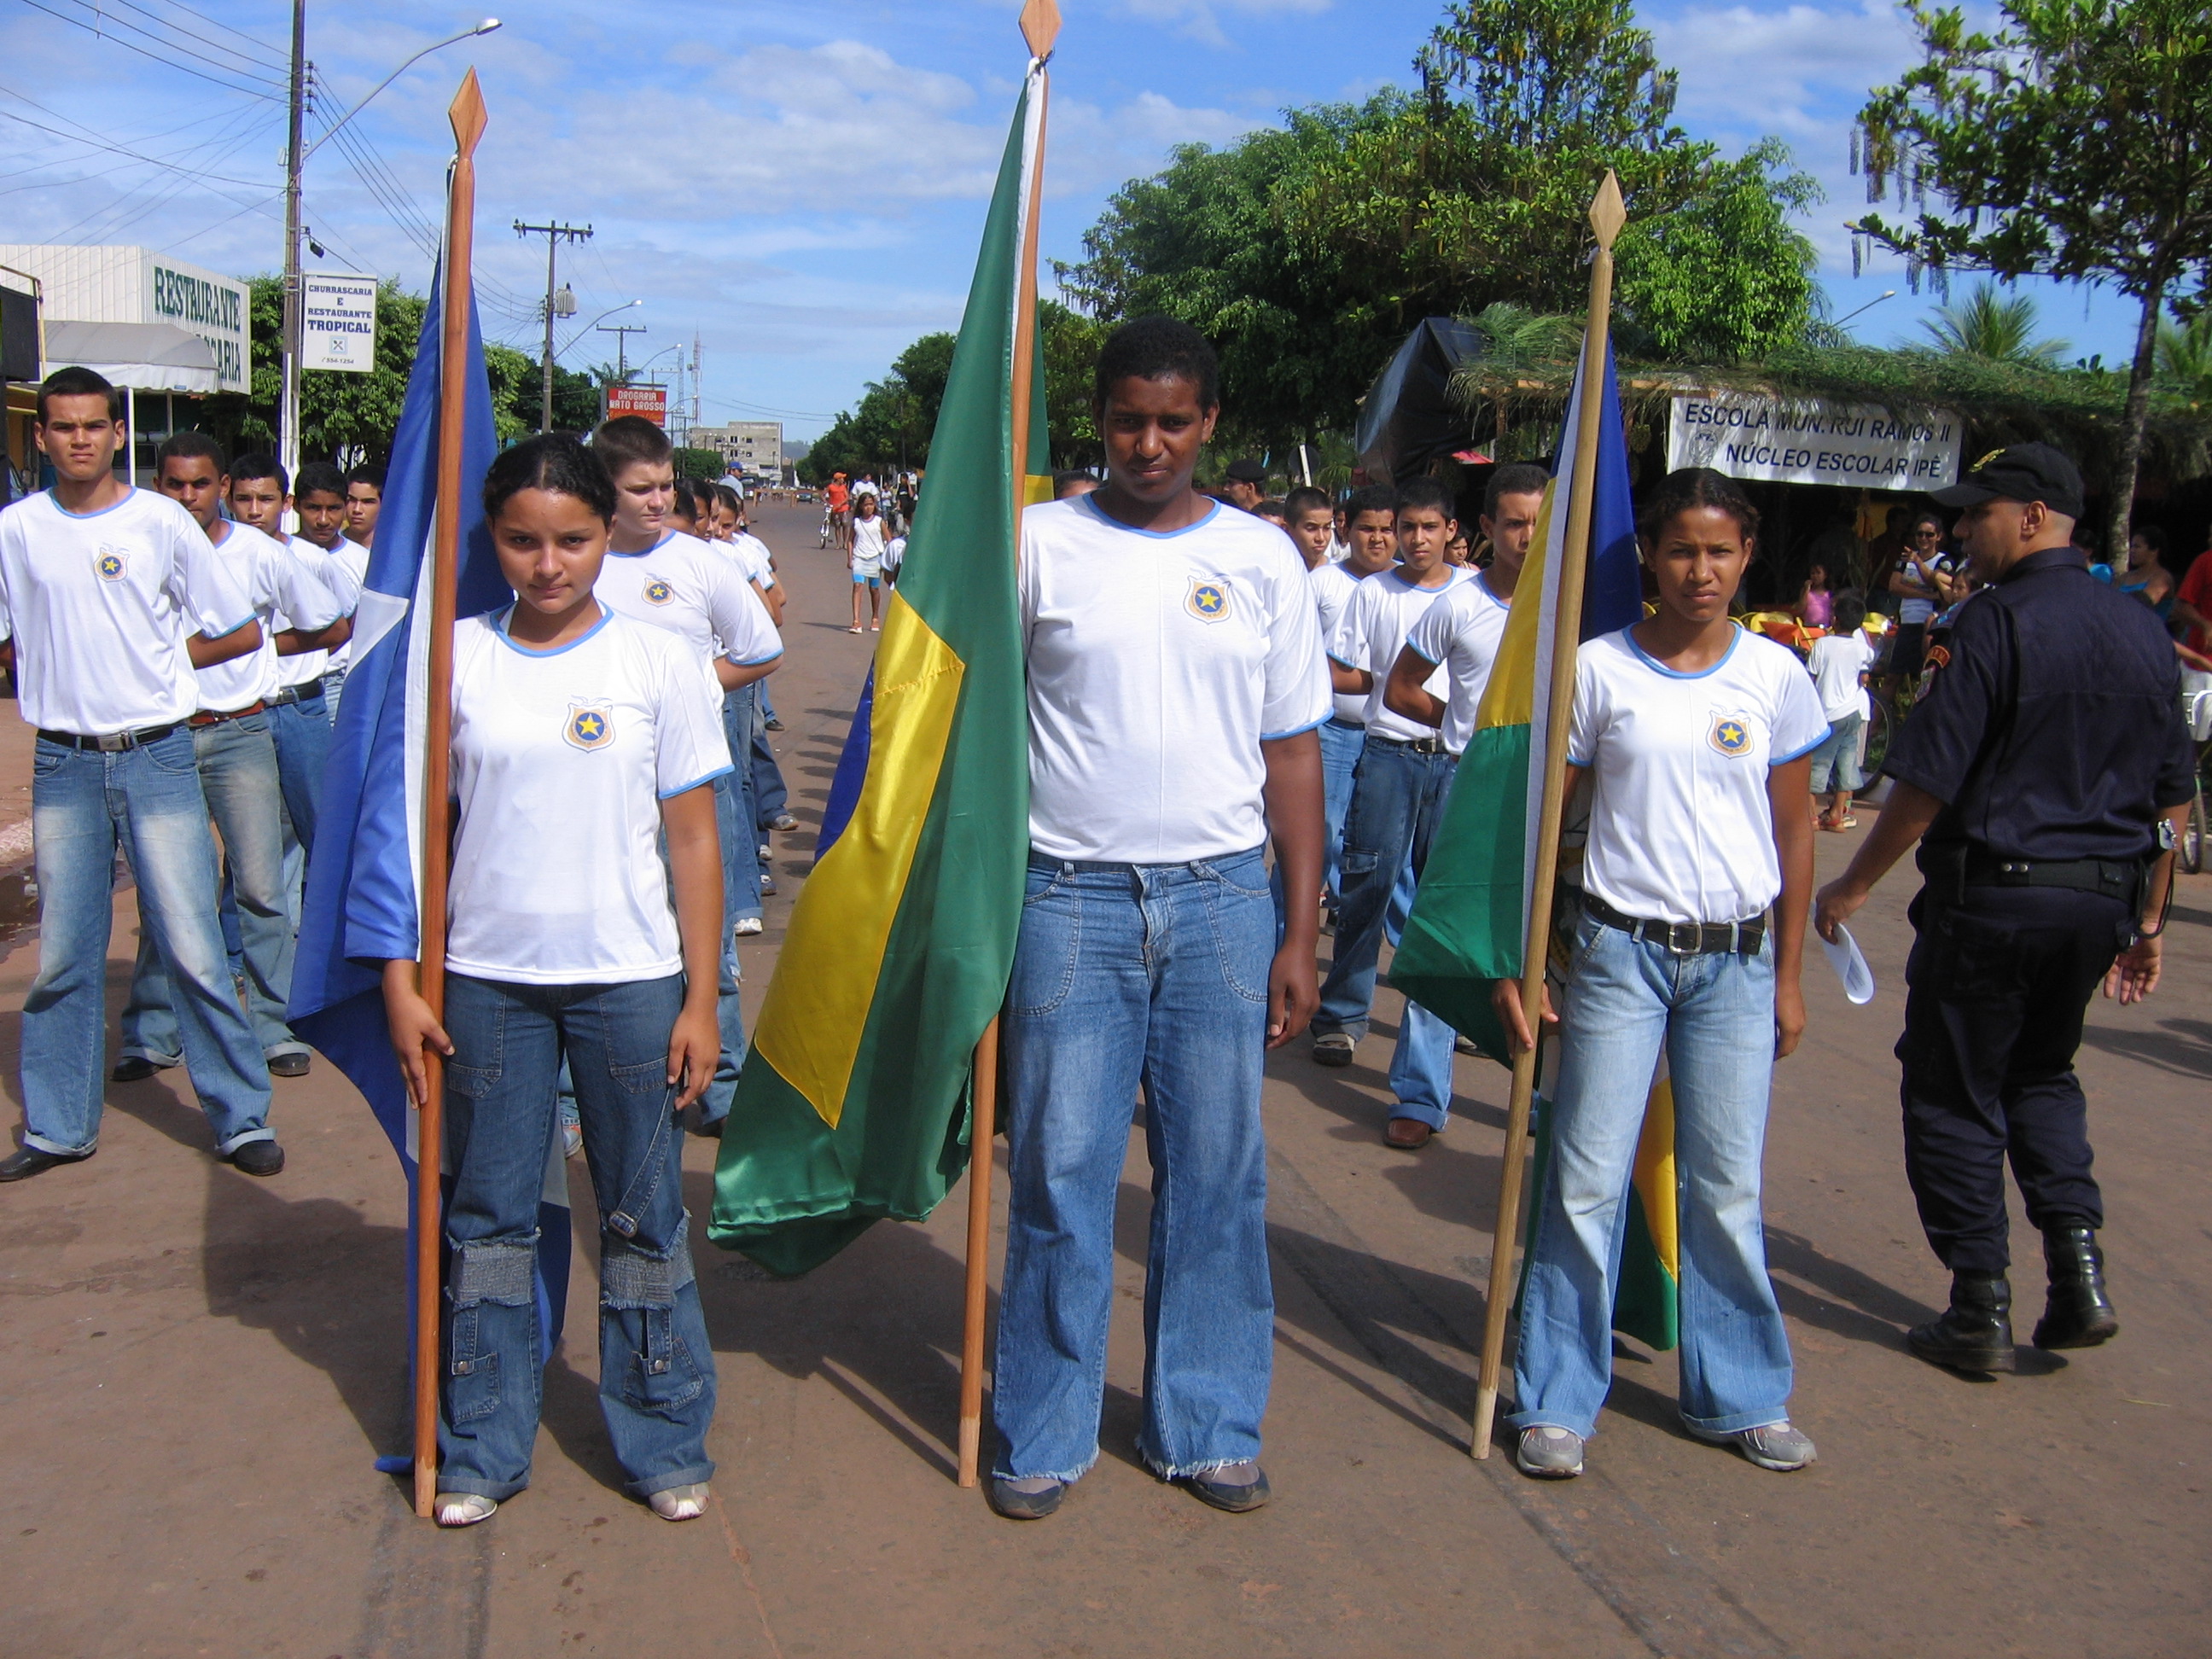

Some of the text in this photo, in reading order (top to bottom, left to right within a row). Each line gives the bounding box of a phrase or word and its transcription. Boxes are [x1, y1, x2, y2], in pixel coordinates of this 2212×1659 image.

[308, 285, 372, 295] CHURRASCARIA
[154, 266, 240, 333] RESTAURANTE
[337, 297, 344, 306] E
[308, 307, 372, 318] RESTAURANTE
[307, 319, 371, 334] TROPICAL
[618, 390, 657, 401] DROGARIA
[609, 399, 665, 411] MATO GROSSO
[1685, 403, 1951, 442] ESCOLA MUN. RUI RAMOS II
[1726, 441, 1941, 478] NÚCLEO ESCOLAR IPÊ
